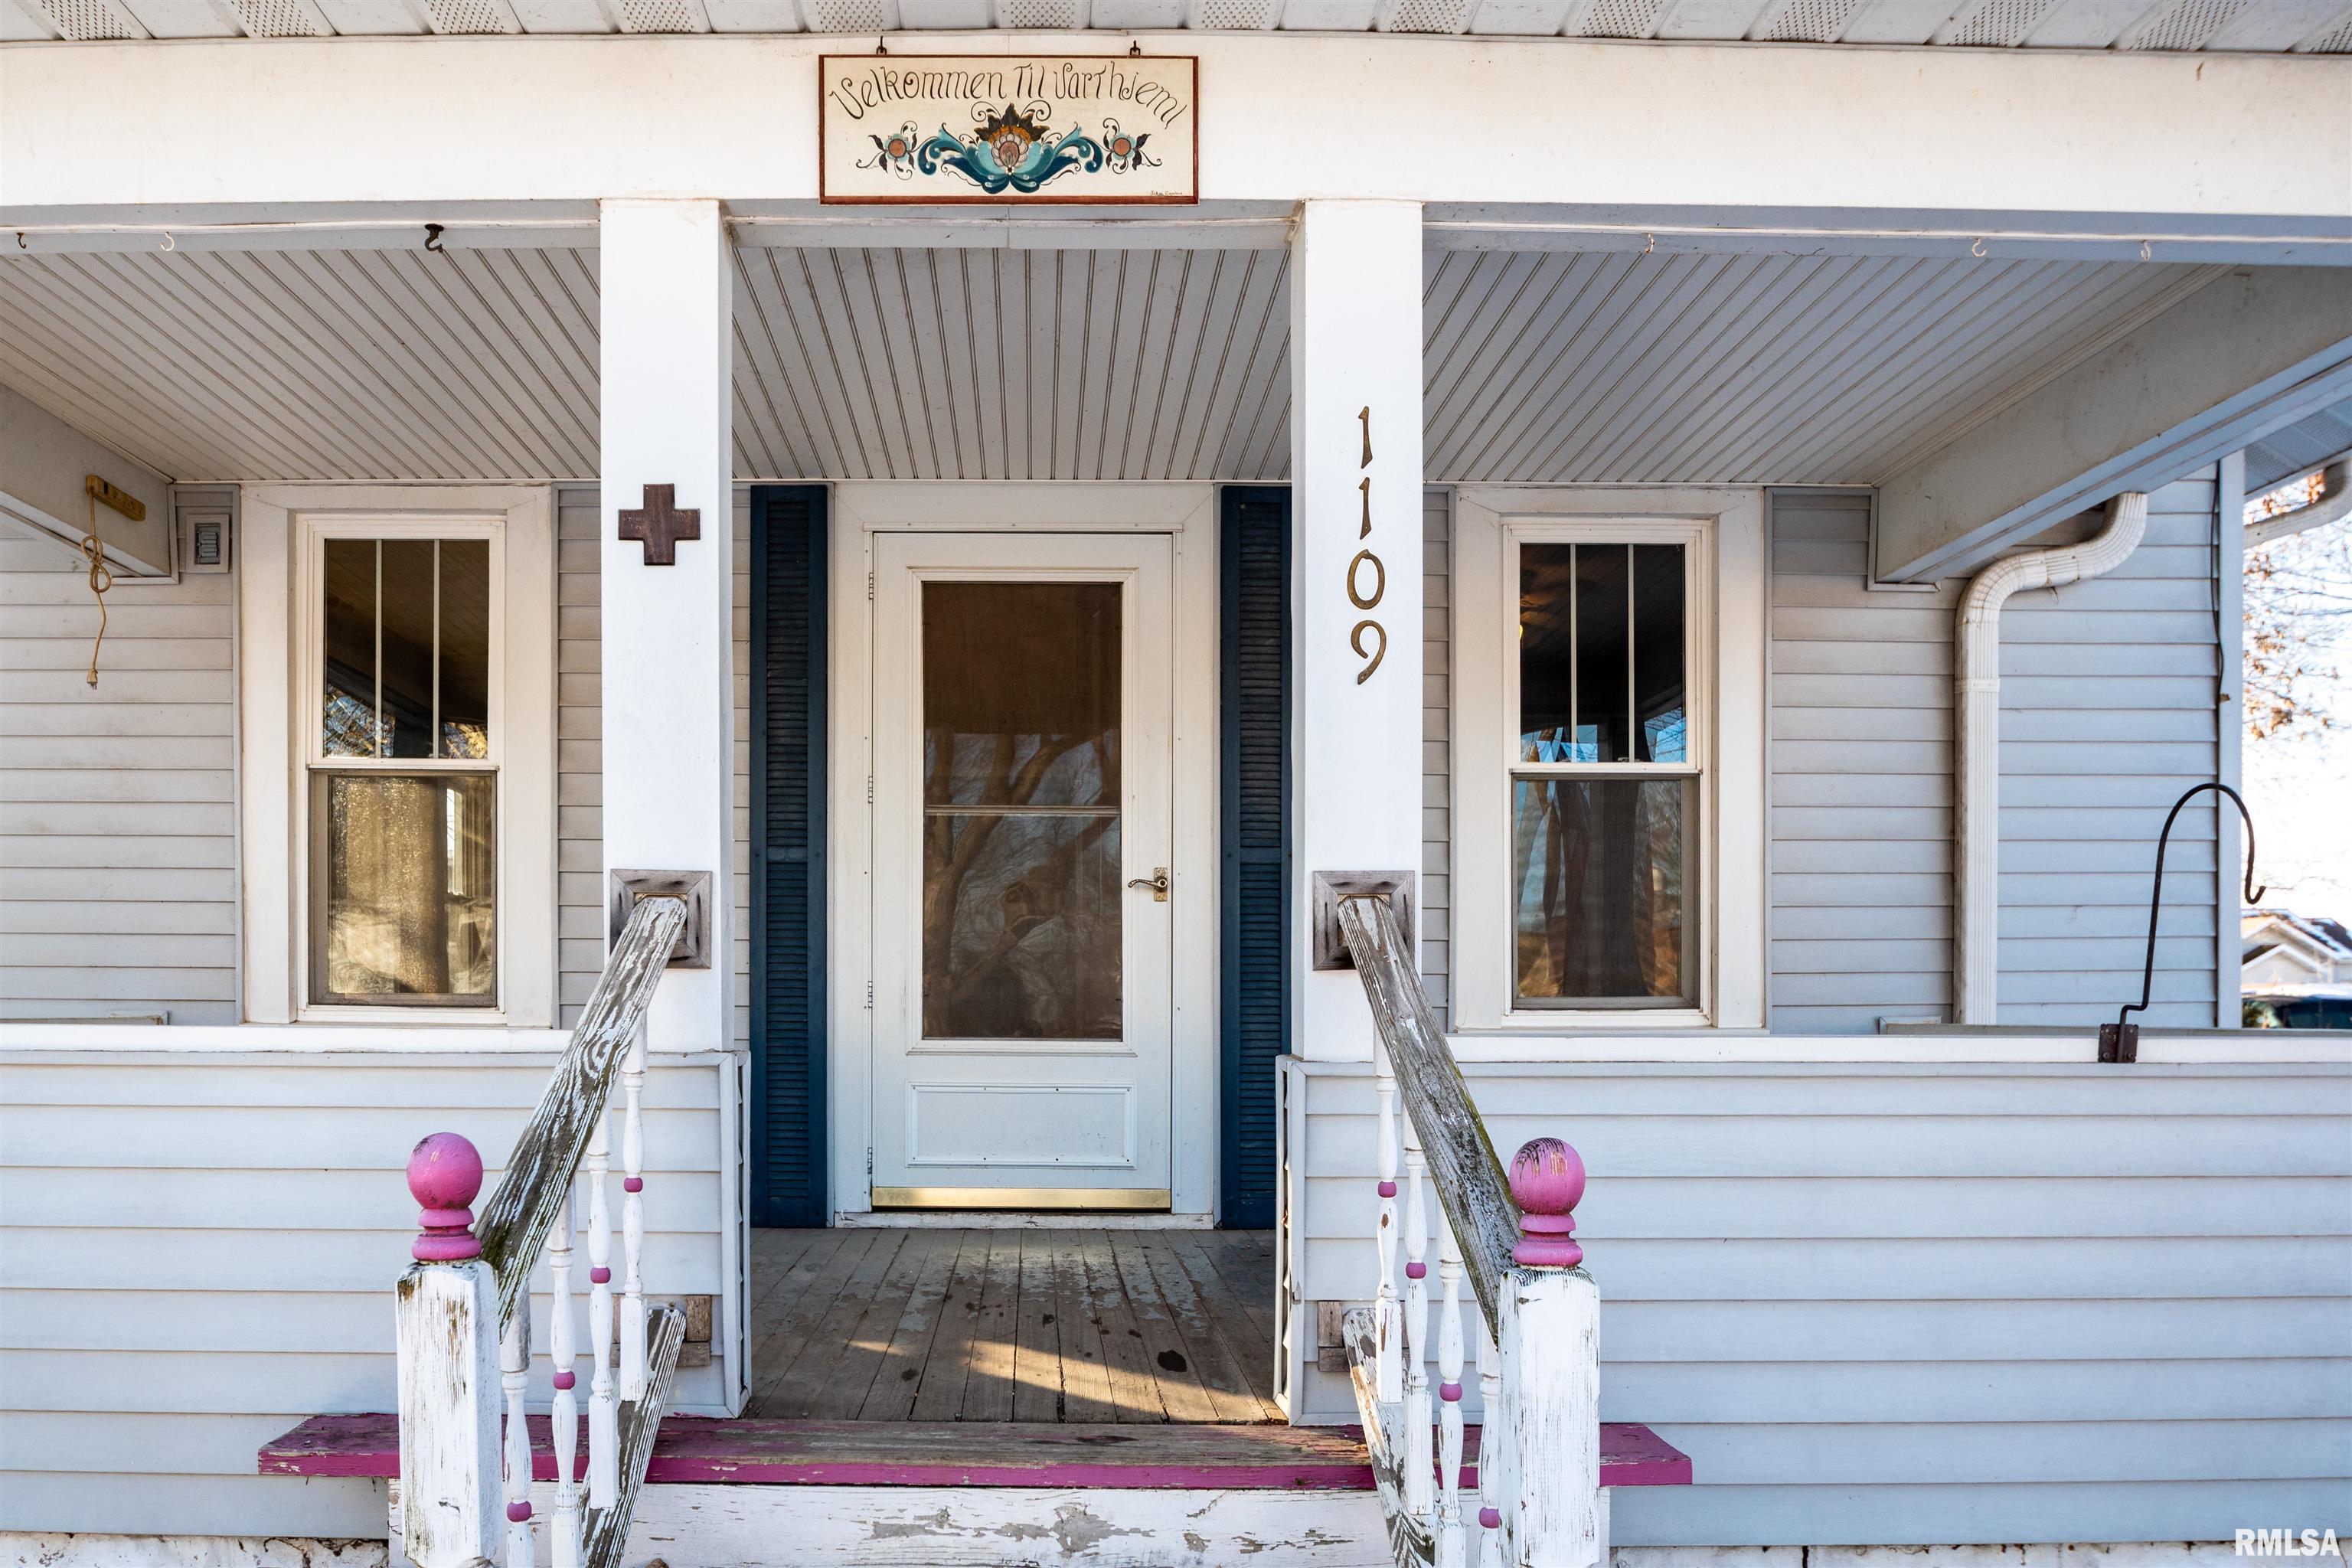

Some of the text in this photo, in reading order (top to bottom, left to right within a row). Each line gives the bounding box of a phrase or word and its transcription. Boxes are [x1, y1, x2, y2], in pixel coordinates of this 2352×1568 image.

[829, 66, 1007, 119] Velkommen
[1014, 63, 1045, 98] Til
[1347, 406, 1387, 685] 1109
